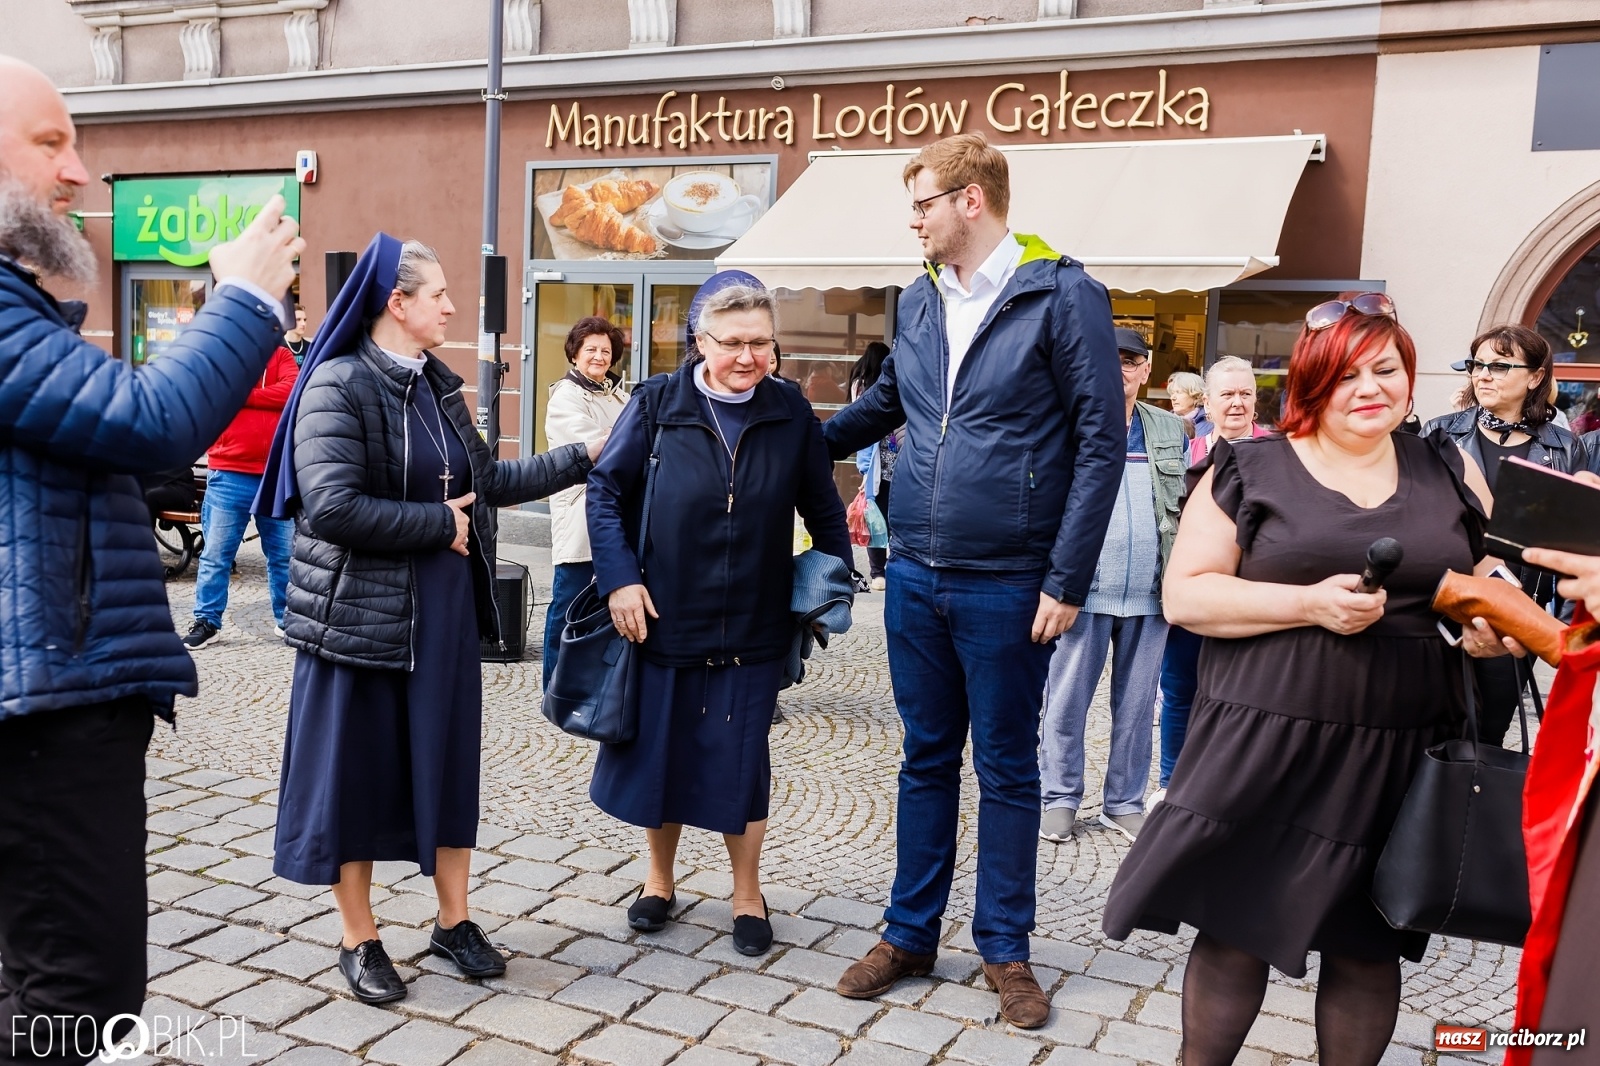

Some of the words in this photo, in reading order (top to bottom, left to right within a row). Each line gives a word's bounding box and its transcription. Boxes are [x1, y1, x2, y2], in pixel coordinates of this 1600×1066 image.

[545, 90, 795, 150] Manufaktura
[812, 83, 968, 143] Lodów
[986, 69, 1210, 136] Gałeczka
